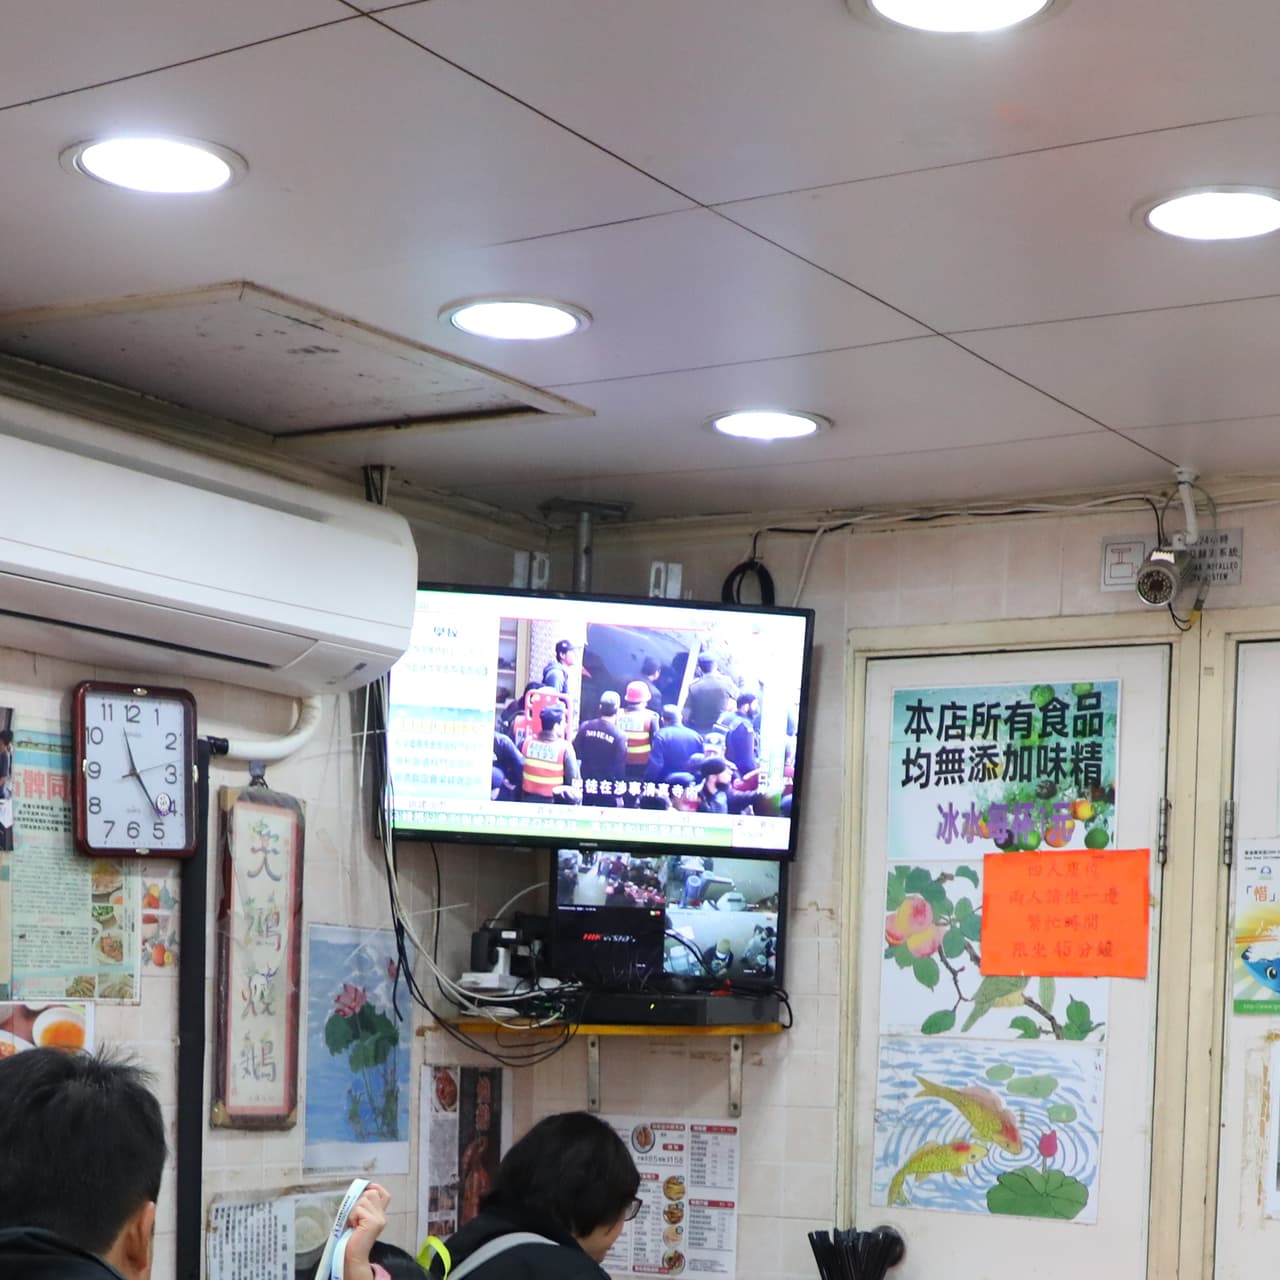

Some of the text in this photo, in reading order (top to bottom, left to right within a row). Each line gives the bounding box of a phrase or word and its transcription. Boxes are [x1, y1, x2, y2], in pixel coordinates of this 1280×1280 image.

[101, 704, 113, 721] 11
[124, 705, 140, 723] 12
[155, 709, 159, 726] 1
[904, 691, 1104, 743] 本店所有食品
[86, 727, 103, 744] 10
[165, 733, 177, 750] 2
[88, 761, 101, 779] 9
[165, 764, 177, 784] 3
[901, 742, 1103, 790] 均無添加味精
[89, 797, 101, 814] 8
[103, 821, 115, 839] 7
[127, 821, 140, 838] 6
[153, 823, 165, 839] 5
